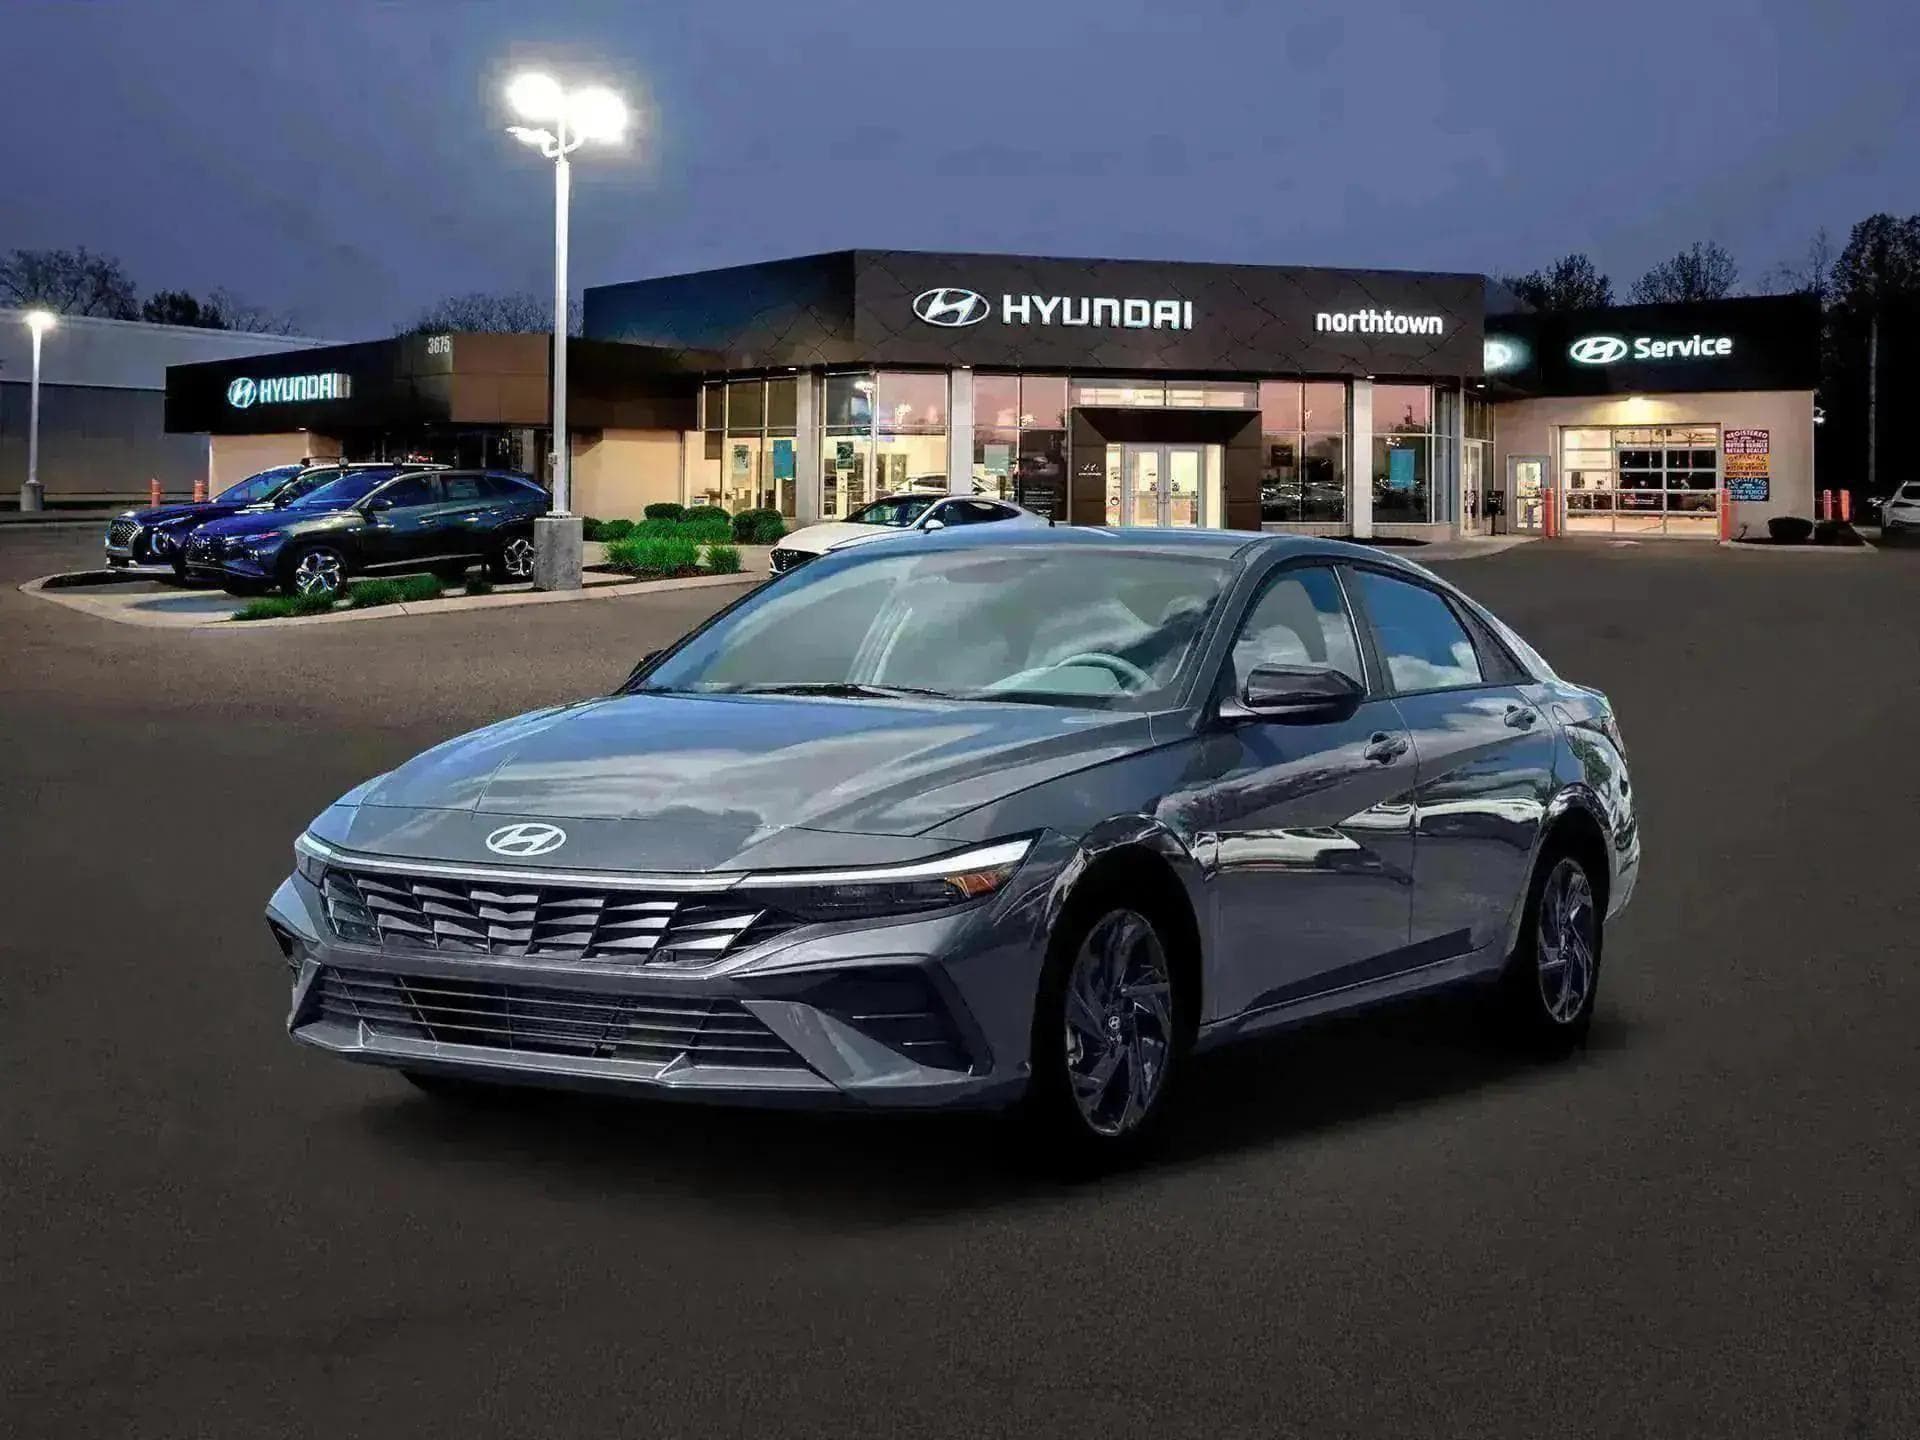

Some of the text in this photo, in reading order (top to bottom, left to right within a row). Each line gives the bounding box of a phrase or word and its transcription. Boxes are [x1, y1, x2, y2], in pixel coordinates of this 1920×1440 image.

[1003, 294, 1193, 330] HYUNDAI
[1316, 309, 1443, 335] northtown
[1634, 335, 1733, 359] Service
[259, 373, 338, 404] HYUNDAI
[1726, 430, 1768, 439] REGISTERED
